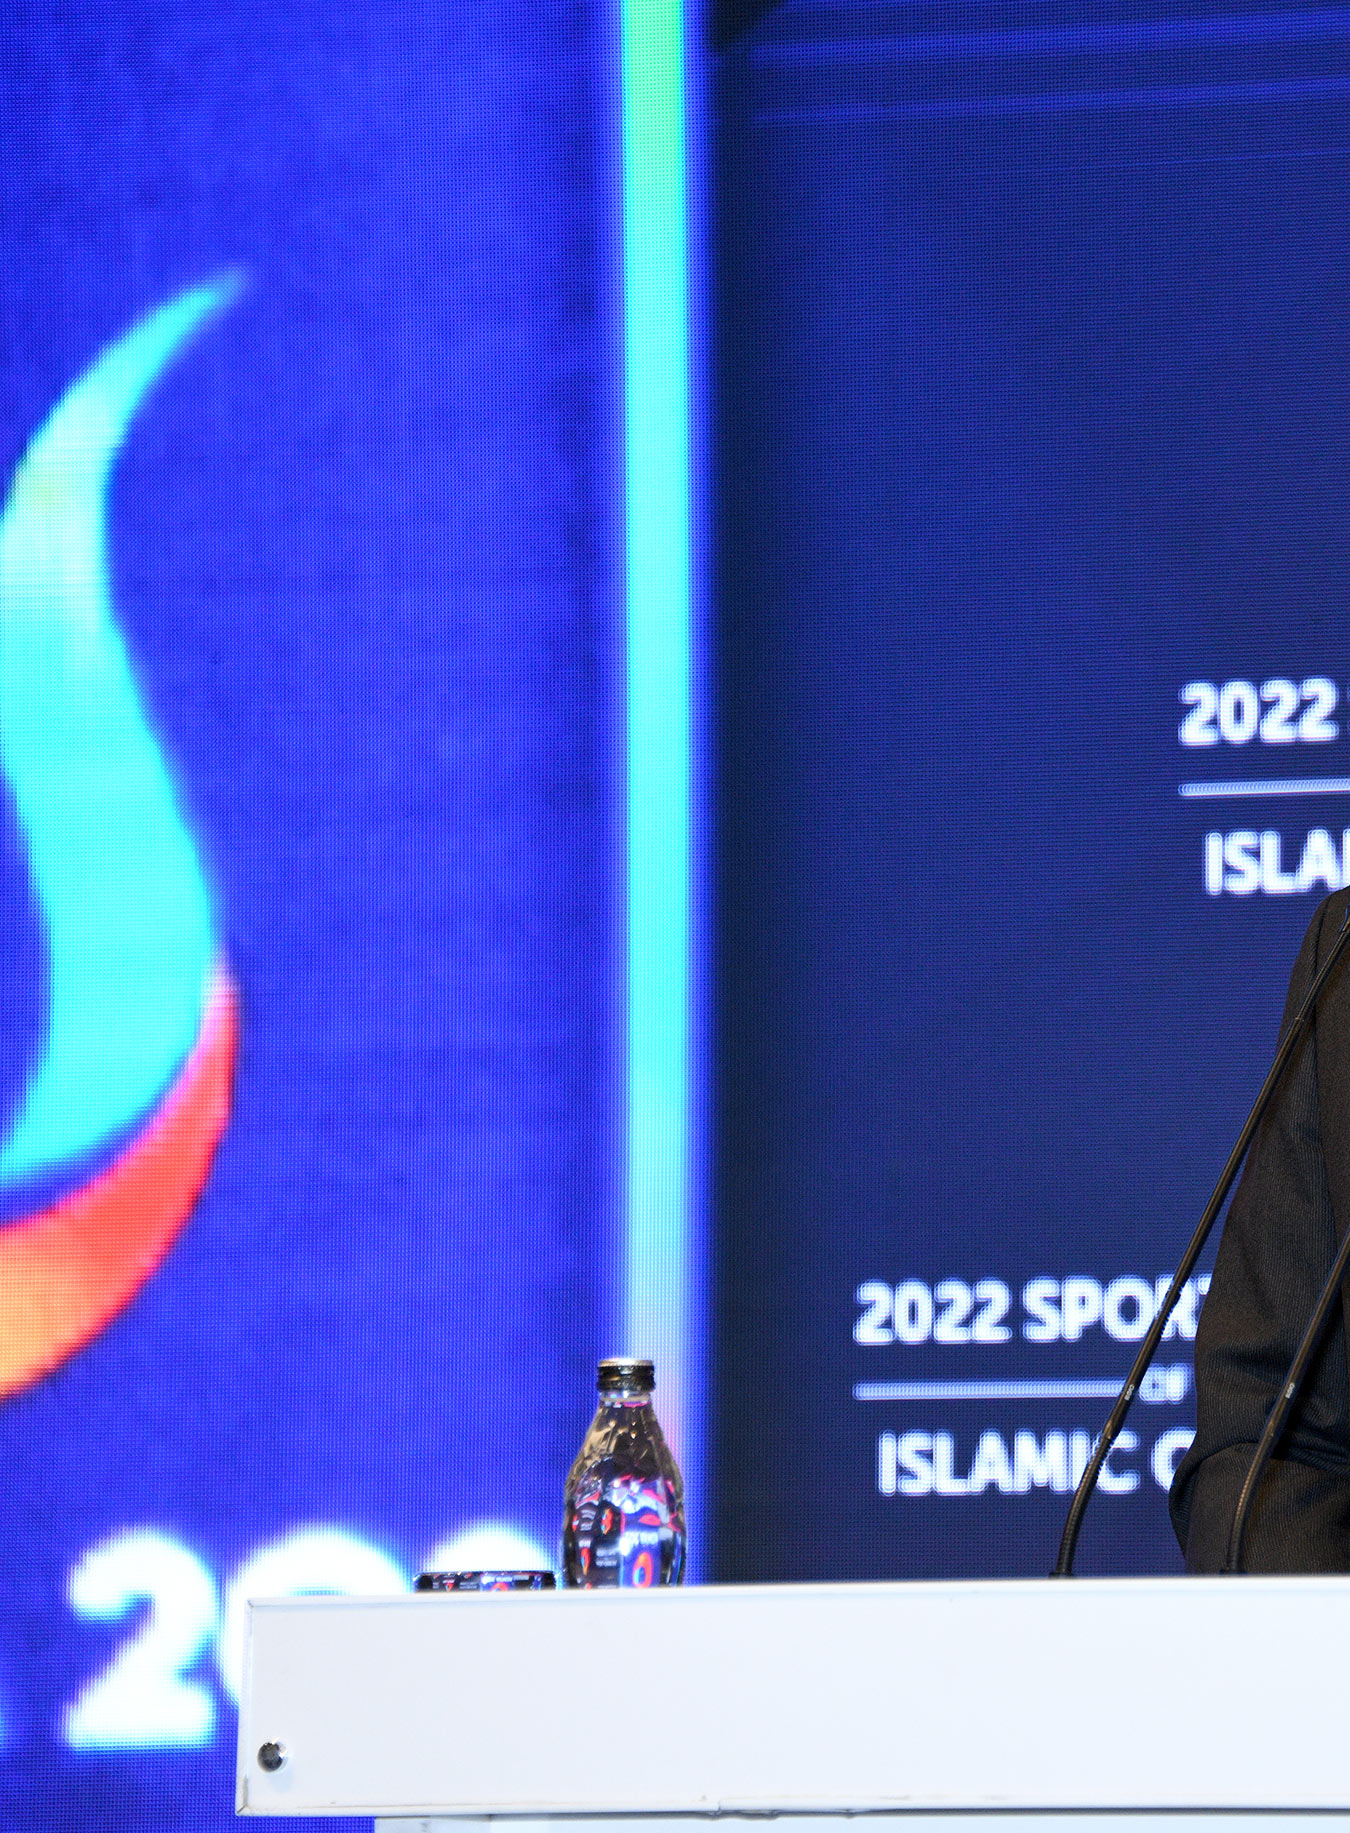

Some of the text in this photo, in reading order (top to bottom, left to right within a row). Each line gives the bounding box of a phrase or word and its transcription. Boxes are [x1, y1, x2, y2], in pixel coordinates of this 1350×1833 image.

[1178, 678, 1339, 746] 2022
[853, 1278, 1012, 1346] 2022
[878, 1428, 1142, 1497] ISLAMIC
